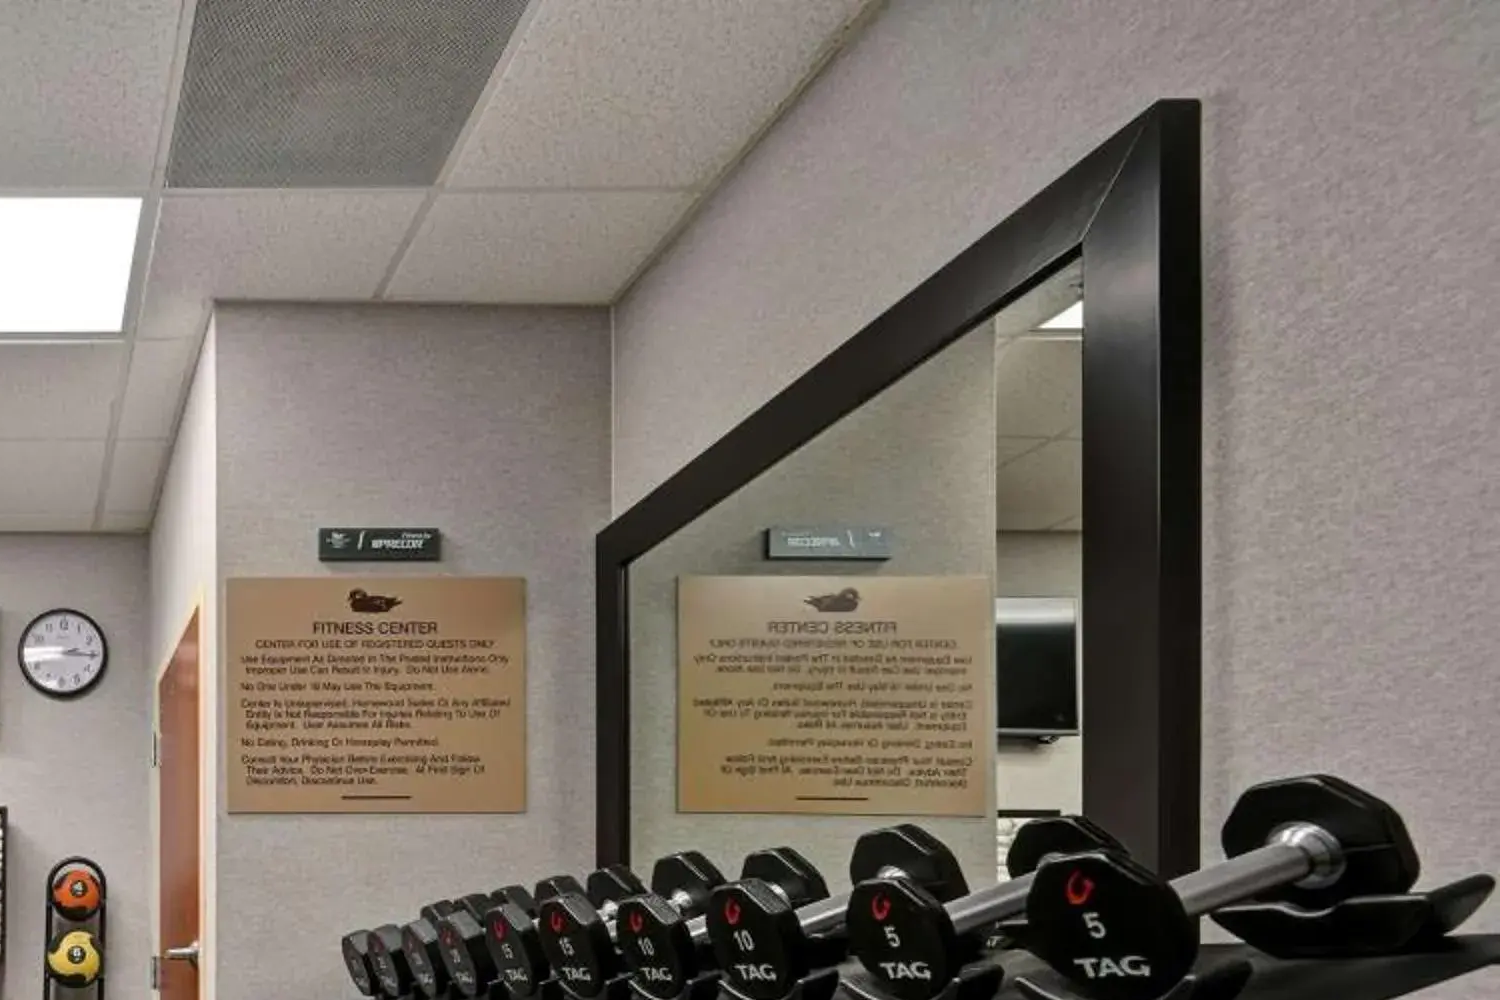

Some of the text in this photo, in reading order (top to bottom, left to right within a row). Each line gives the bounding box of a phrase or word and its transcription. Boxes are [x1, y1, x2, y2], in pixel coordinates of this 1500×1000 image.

[312, 621, 438, 635] FITNESS CENTER
[255, 639, 295, 649] CENTER
[297, 639, 319, 649] FOR
[1083, 912, 1107, 938] 5
[558, 936, 575, 957] 15
[637, 936, 655, 957] 10
[733, 929, 755, 952] 10
[884, 925, 900, 948] 5
[561, 967, 592, 982] TAG
[640, 967, 673, 982] TAG
[734, 963, 777, 981] TAG
[879, 961, 932, 980] TAG
[1073, 955, 1151, 979] TAG
